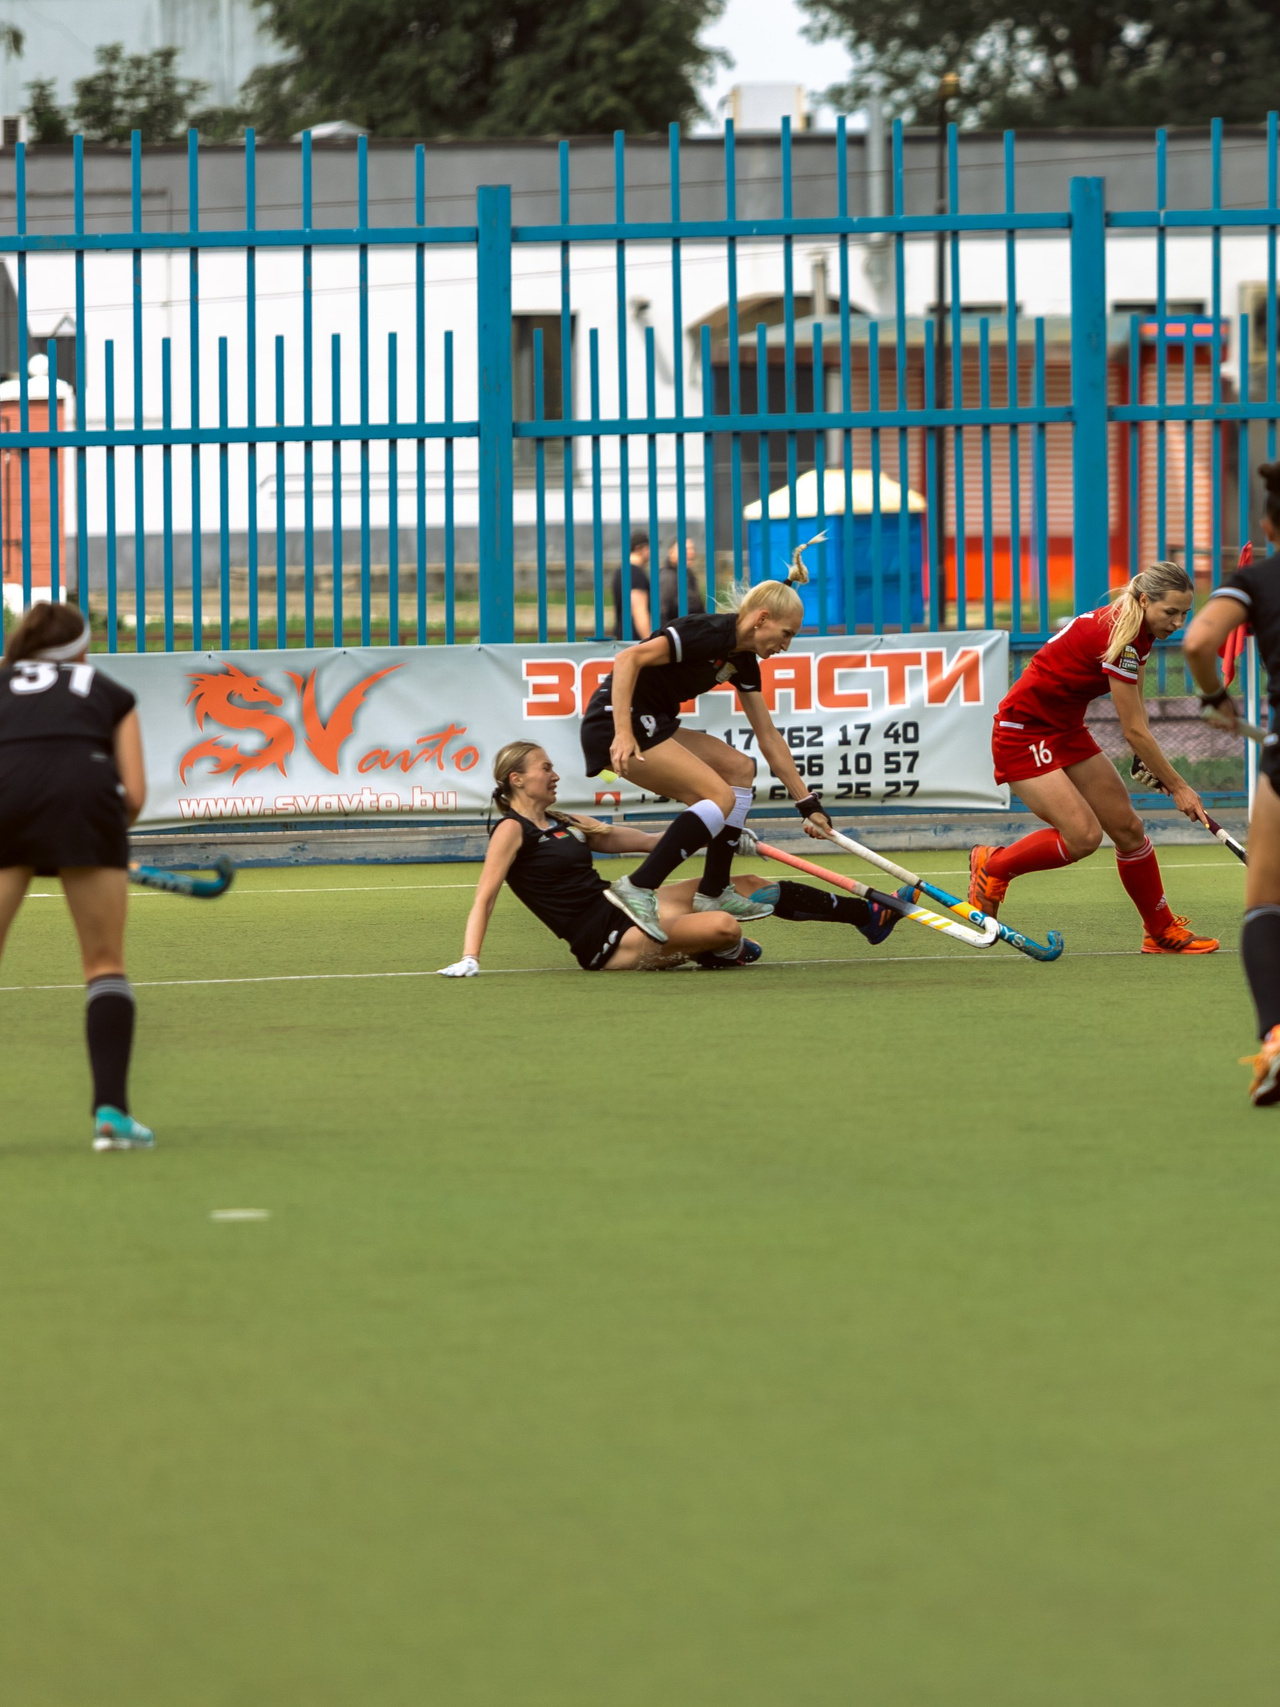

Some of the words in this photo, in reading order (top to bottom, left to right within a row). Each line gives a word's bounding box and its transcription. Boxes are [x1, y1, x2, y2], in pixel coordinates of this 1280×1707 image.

[521, 645, 986, 720] ЗАСТИ
[718, 727, 756, 750] 17
[838, 722, 872, 746] 17
[883, 721, 920, 745] 40
[838, 752, 872, 776] 10
[884, 750, 920, 774] 57
[1028, 739, 1053, 768] 16
[178, 785, 457, 820] www.svavto.by
[769, 783, 824, 801] 66
[834, 781, 872, 800] 25
[882, 780, 920, 798] 27
[968, 910, 1028, 948] GYS
